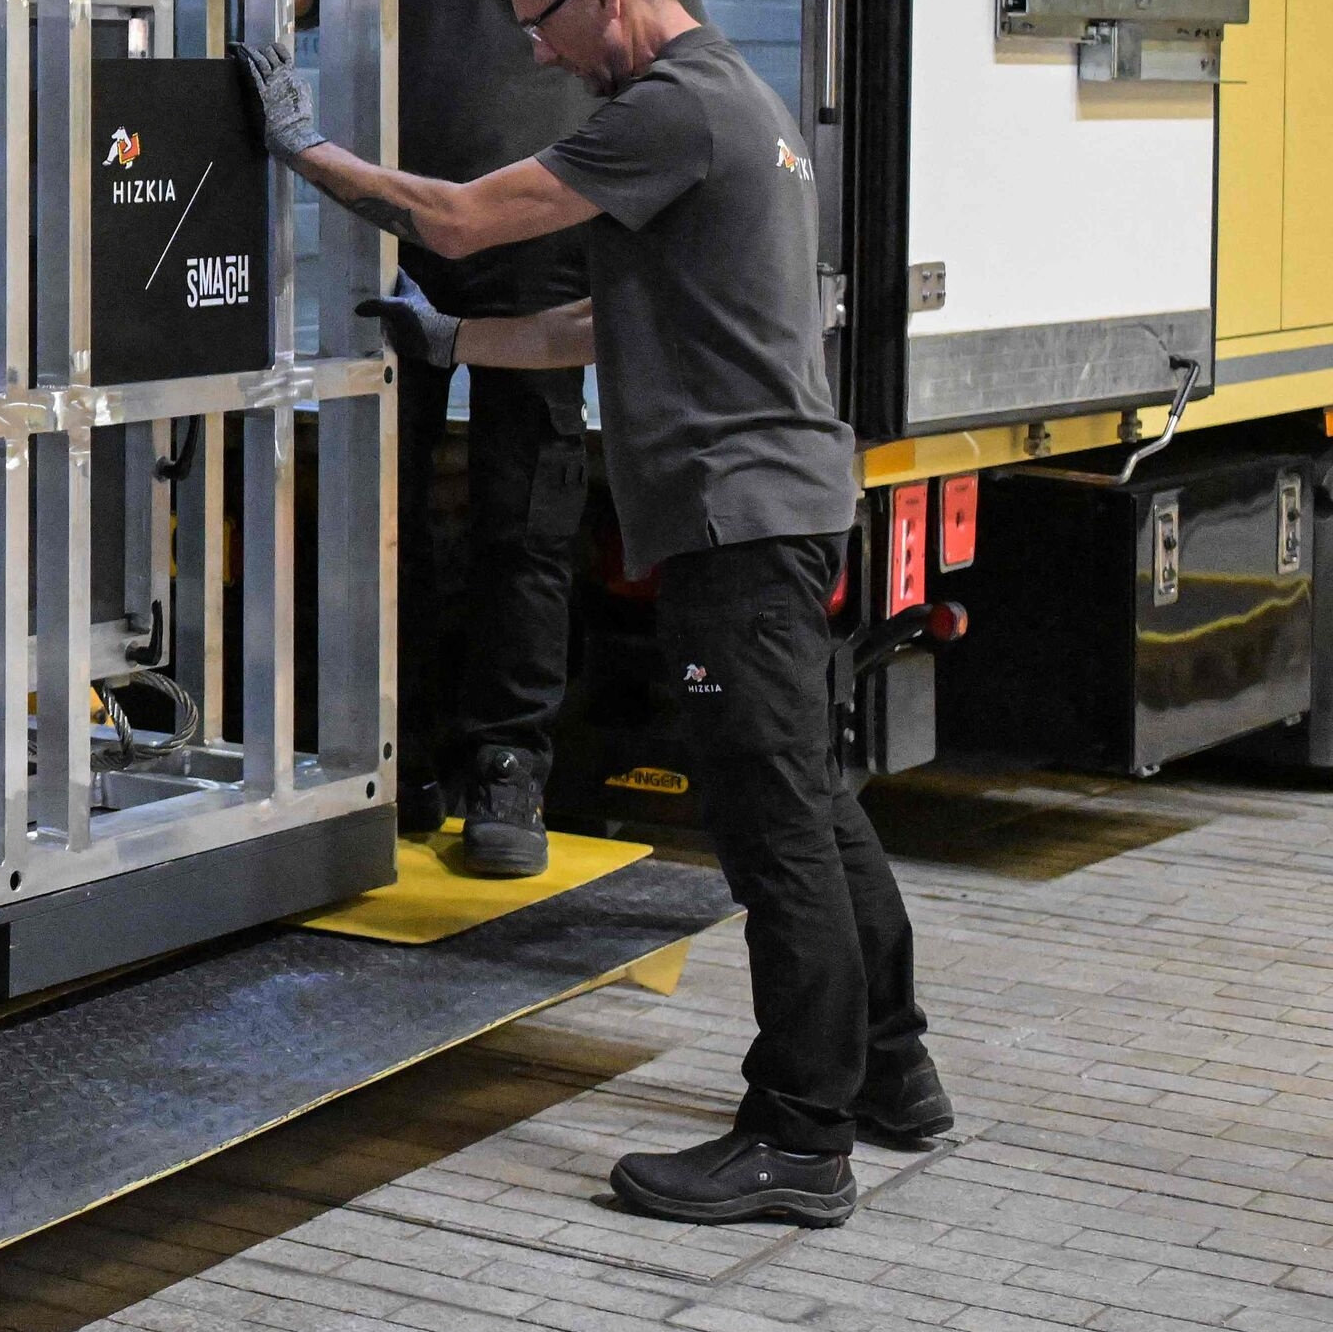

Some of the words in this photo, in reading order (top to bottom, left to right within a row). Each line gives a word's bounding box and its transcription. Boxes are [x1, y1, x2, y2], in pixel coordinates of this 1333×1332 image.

[113, 178, 176, 204] HIZKIA
[186, 254, 249, 308] SMACH
[688, 683, 723, 693] HIZKIA
